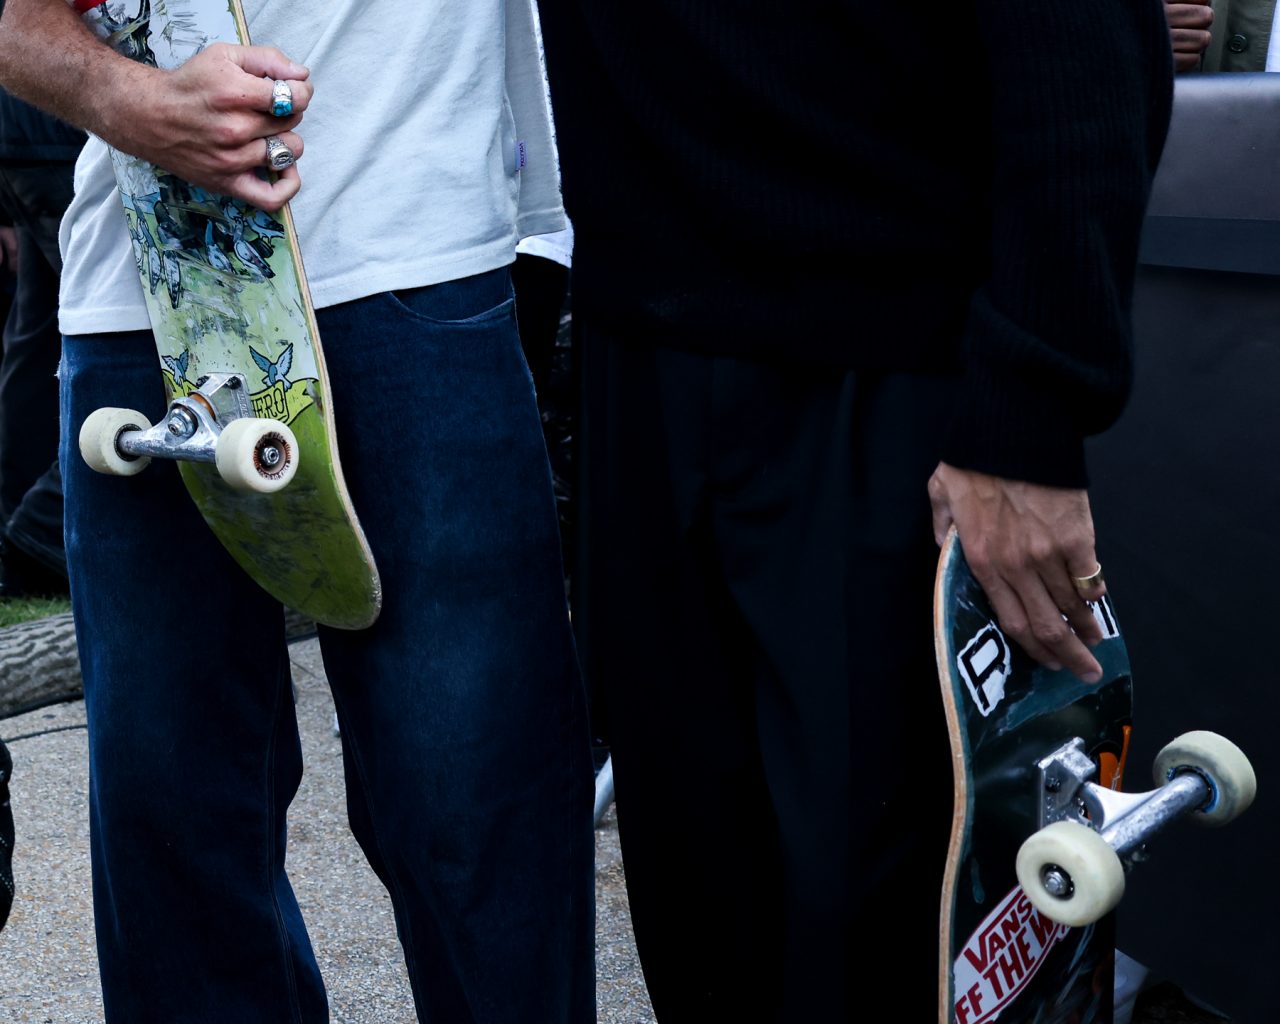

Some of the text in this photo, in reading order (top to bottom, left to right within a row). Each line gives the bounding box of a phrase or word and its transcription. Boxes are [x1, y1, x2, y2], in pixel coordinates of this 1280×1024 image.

[955, 982, 983, 1024] FF
[983, 926, 1036, 1000] THE
[963, 889, 1033, 974] VANS
